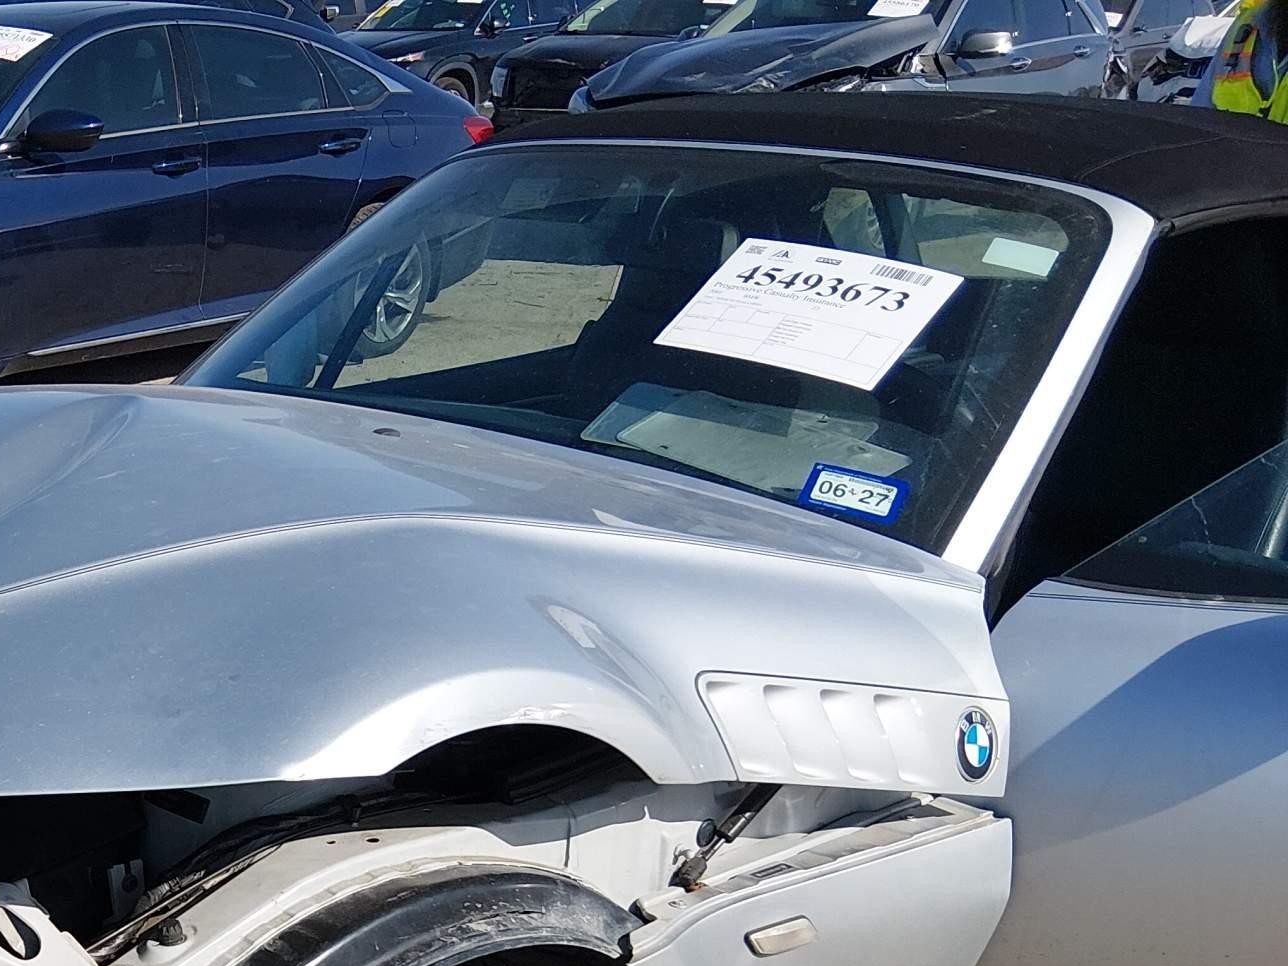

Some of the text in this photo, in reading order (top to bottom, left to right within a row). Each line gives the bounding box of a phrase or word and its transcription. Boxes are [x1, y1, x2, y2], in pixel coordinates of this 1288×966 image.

[735, 264, 912, 313] 45493673
[817, 480, 849, 499] 06
[858, 489, 890, 508] 27
[960, 711, 993, 735] BMW
